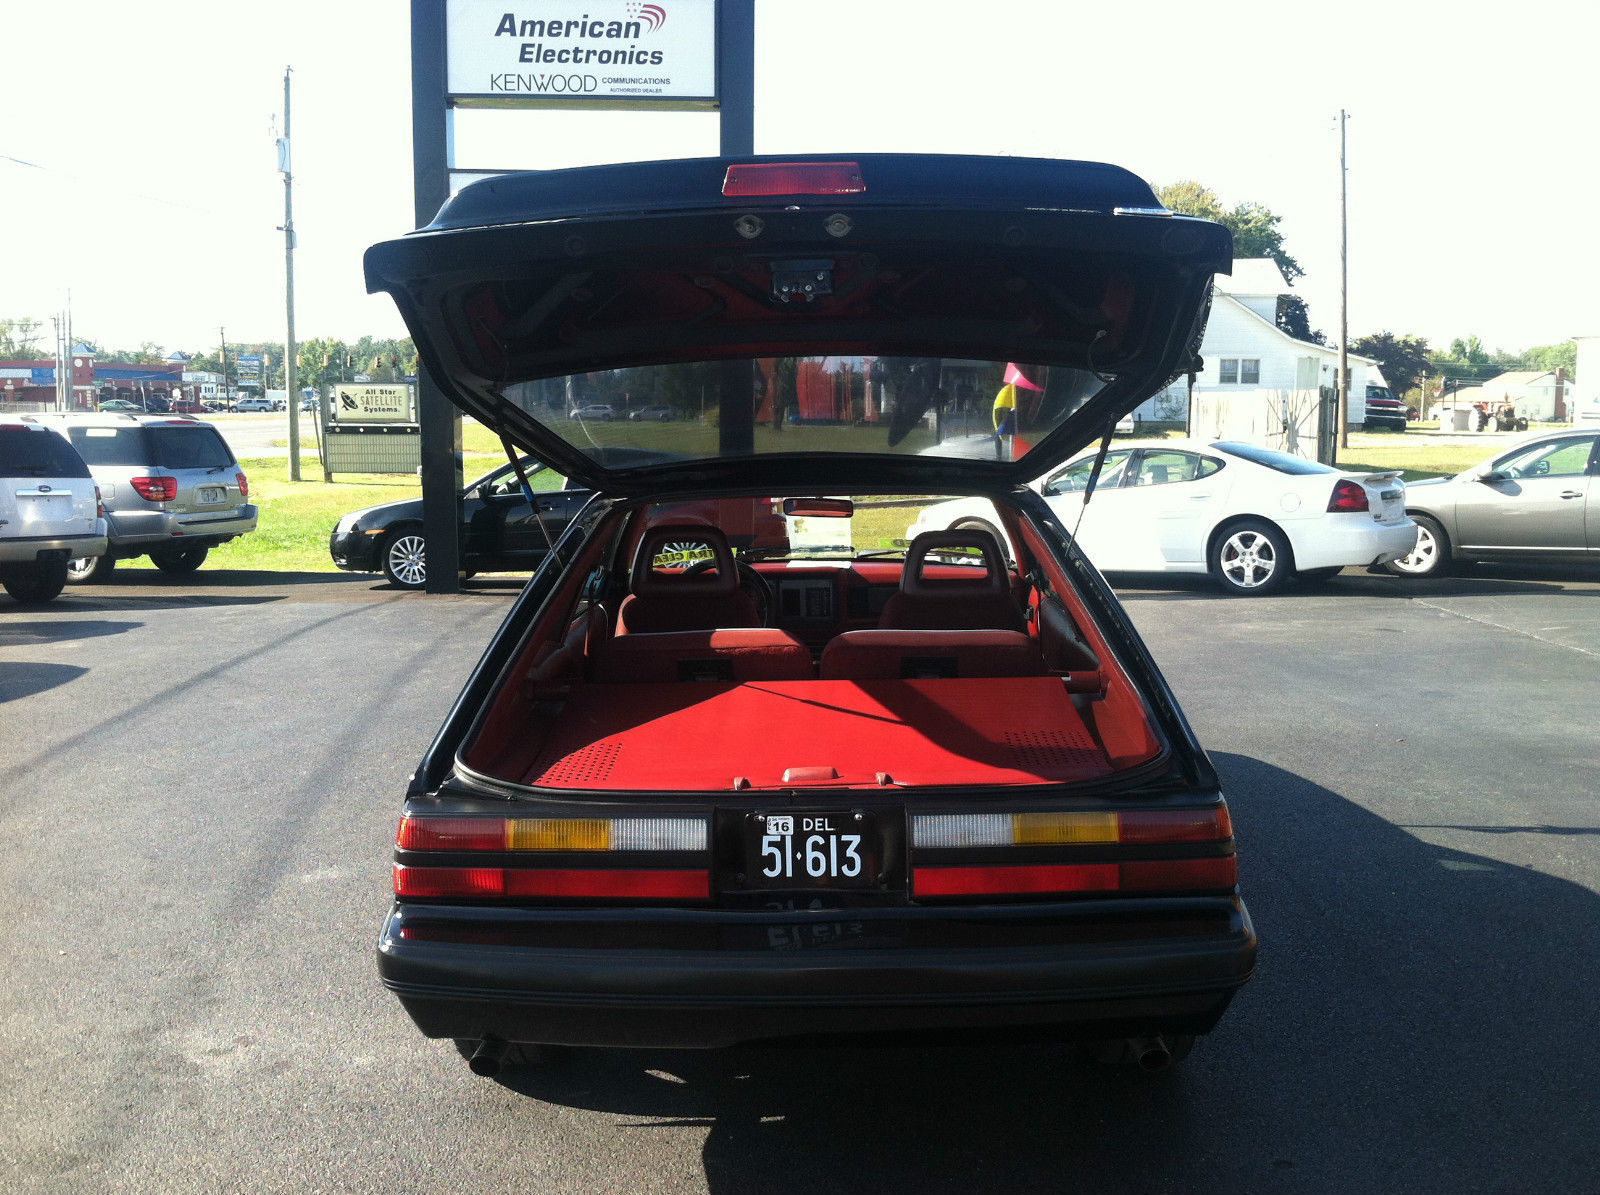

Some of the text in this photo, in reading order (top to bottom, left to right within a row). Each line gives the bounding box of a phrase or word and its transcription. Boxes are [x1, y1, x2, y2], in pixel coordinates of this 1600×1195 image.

[494, 13, 641, 39] American
[518, 43, 664, 66] Electronics
[490, 73, 598, 93] KENWOOD
[601, 77, 671, 85] COMMUNICATIONS
[360, 395, 403, 406] SATELLITE
[773, 821, 790, 832] 16
[802, 817, 836, 832] DEL
